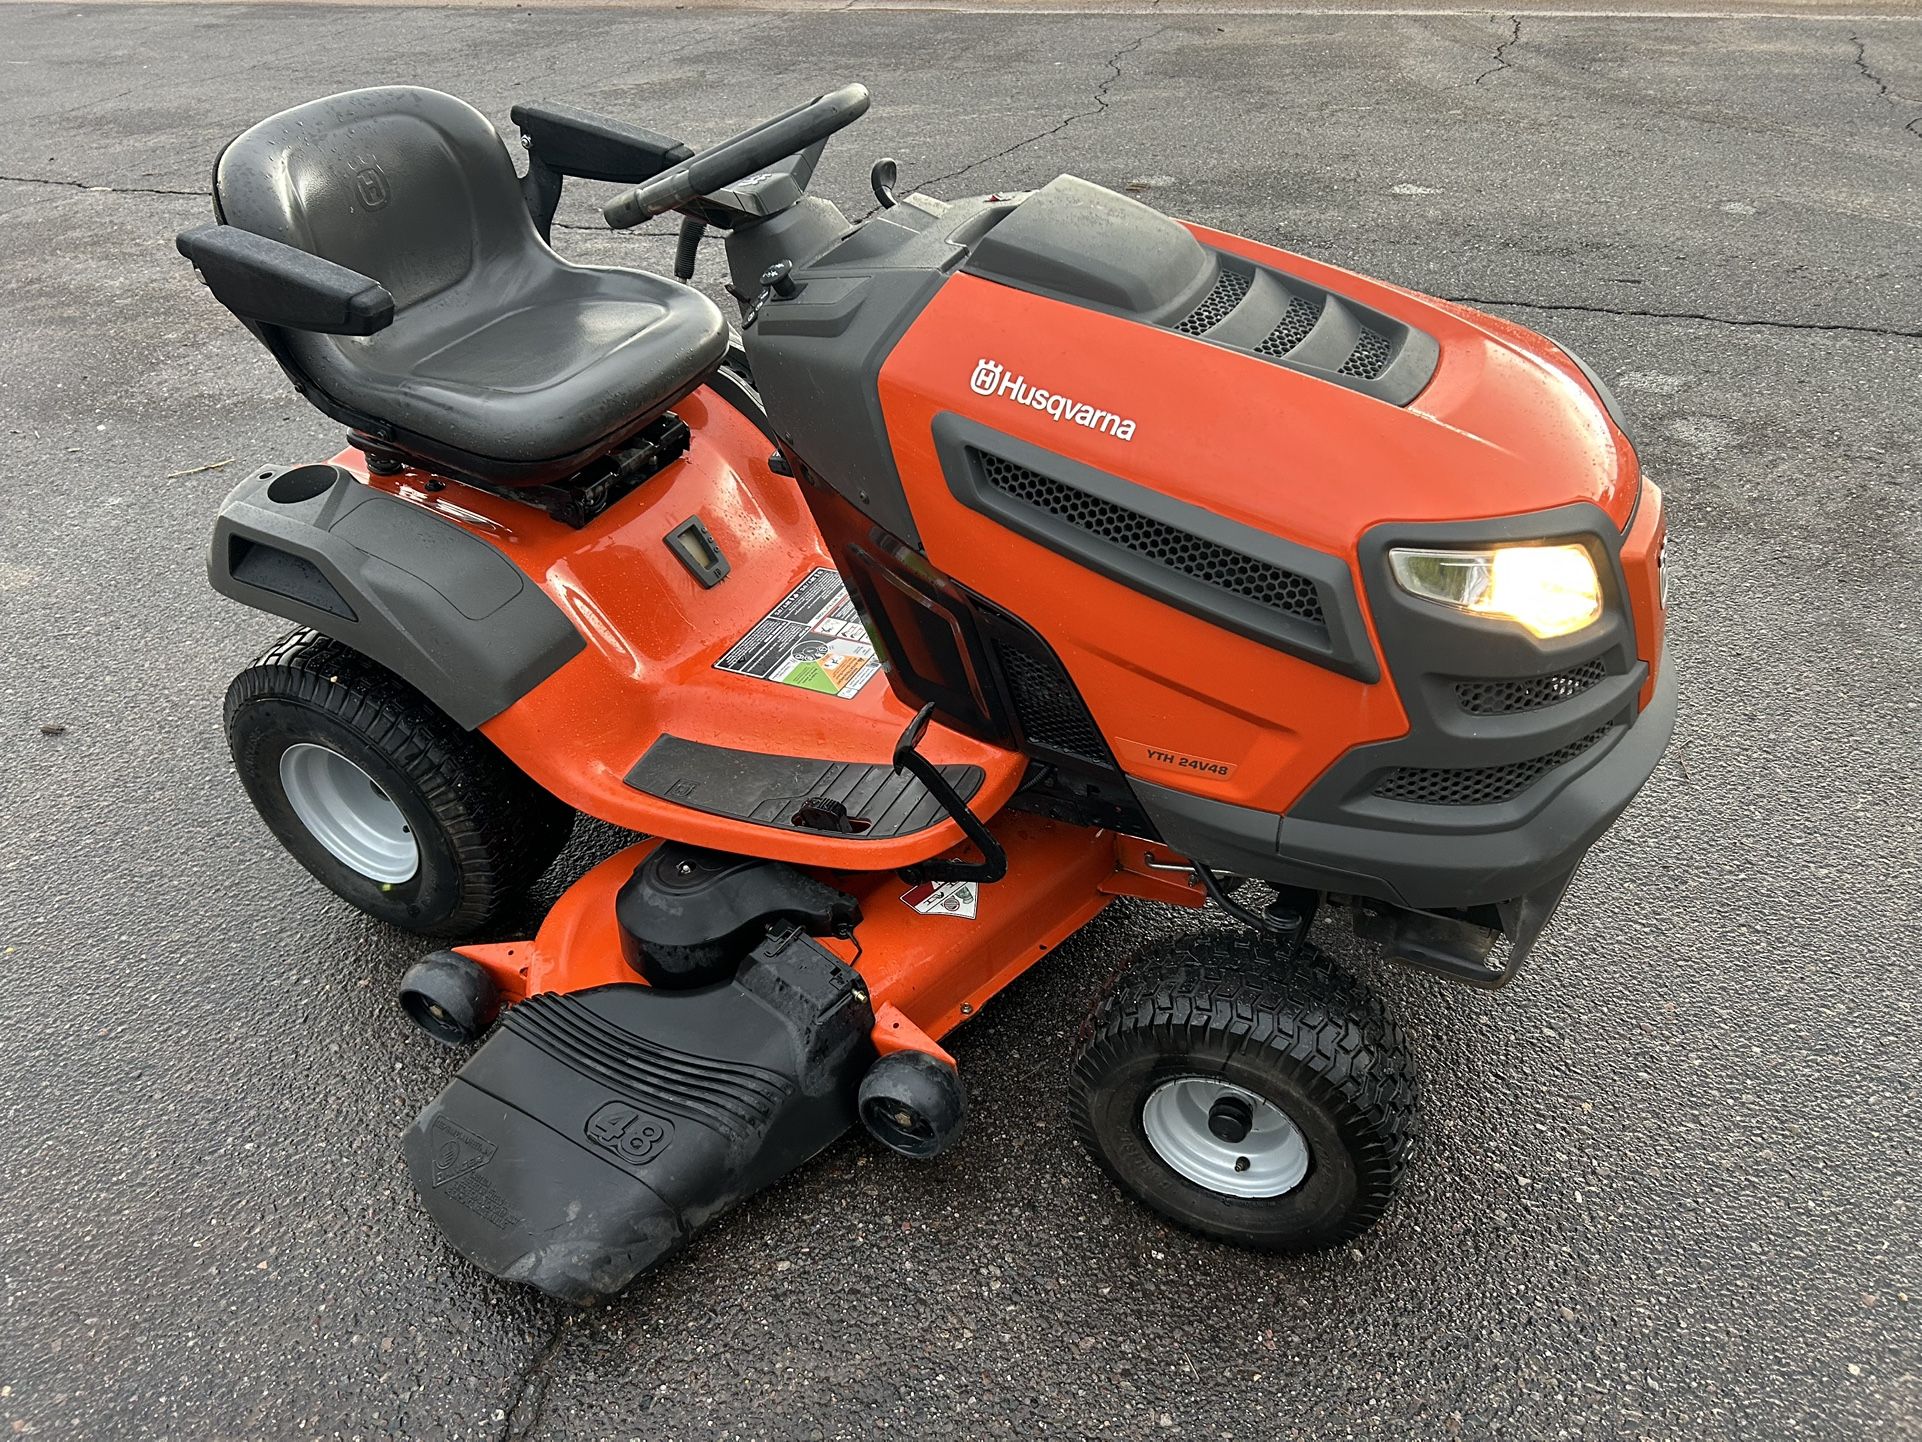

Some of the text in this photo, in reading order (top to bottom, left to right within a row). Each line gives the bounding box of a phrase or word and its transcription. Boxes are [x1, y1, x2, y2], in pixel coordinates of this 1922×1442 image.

[997, 371, 1136, 441] Husqvarna
[1146, 749, 1229, 776] YTH 24V48
[589, 1110, 665, 1157] 48
